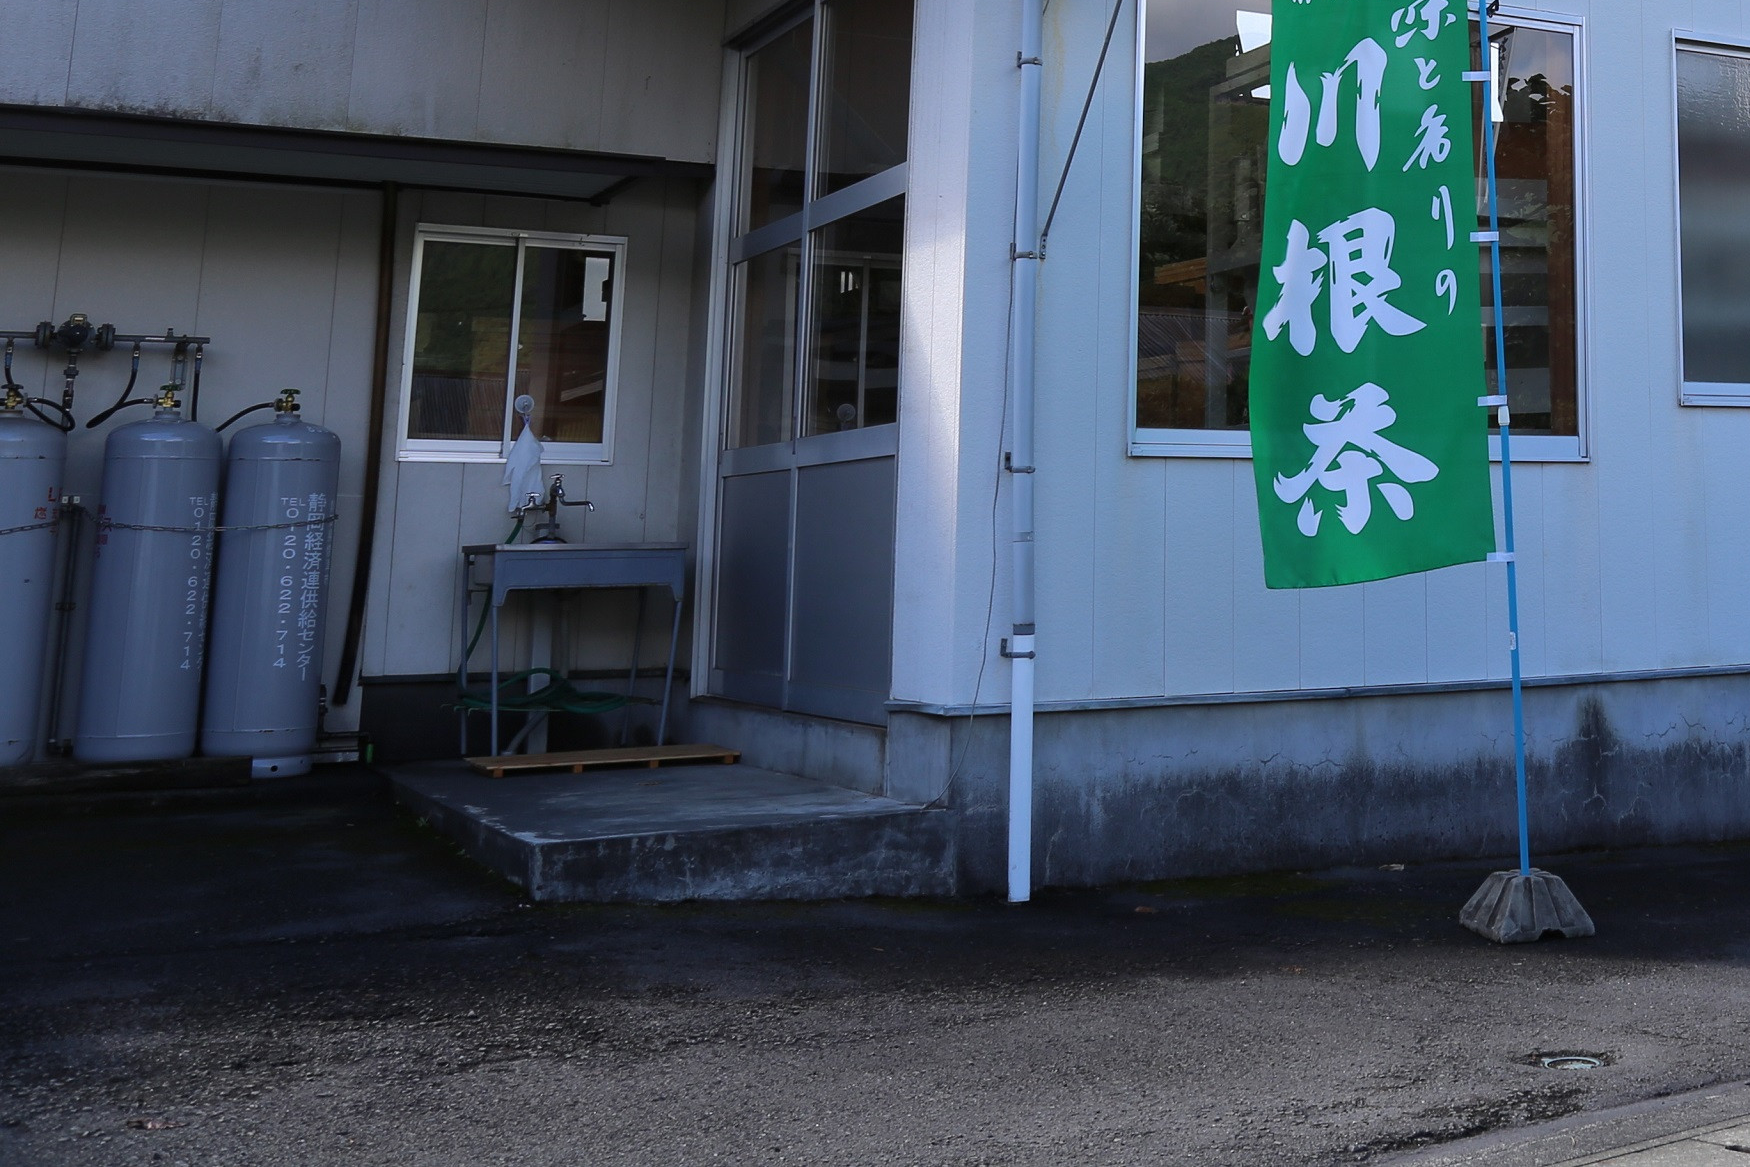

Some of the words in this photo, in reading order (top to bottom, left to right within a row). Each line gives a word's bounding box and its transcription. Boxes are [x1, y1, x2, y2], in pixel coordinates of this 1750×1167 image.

[1261, 36, 1439, 538] 川根茶
[189, 497, 208, 506] TEL
[281, 497, 306, 506] TEL
[296, 493, 327, 681] 静岡経済連供給センター
